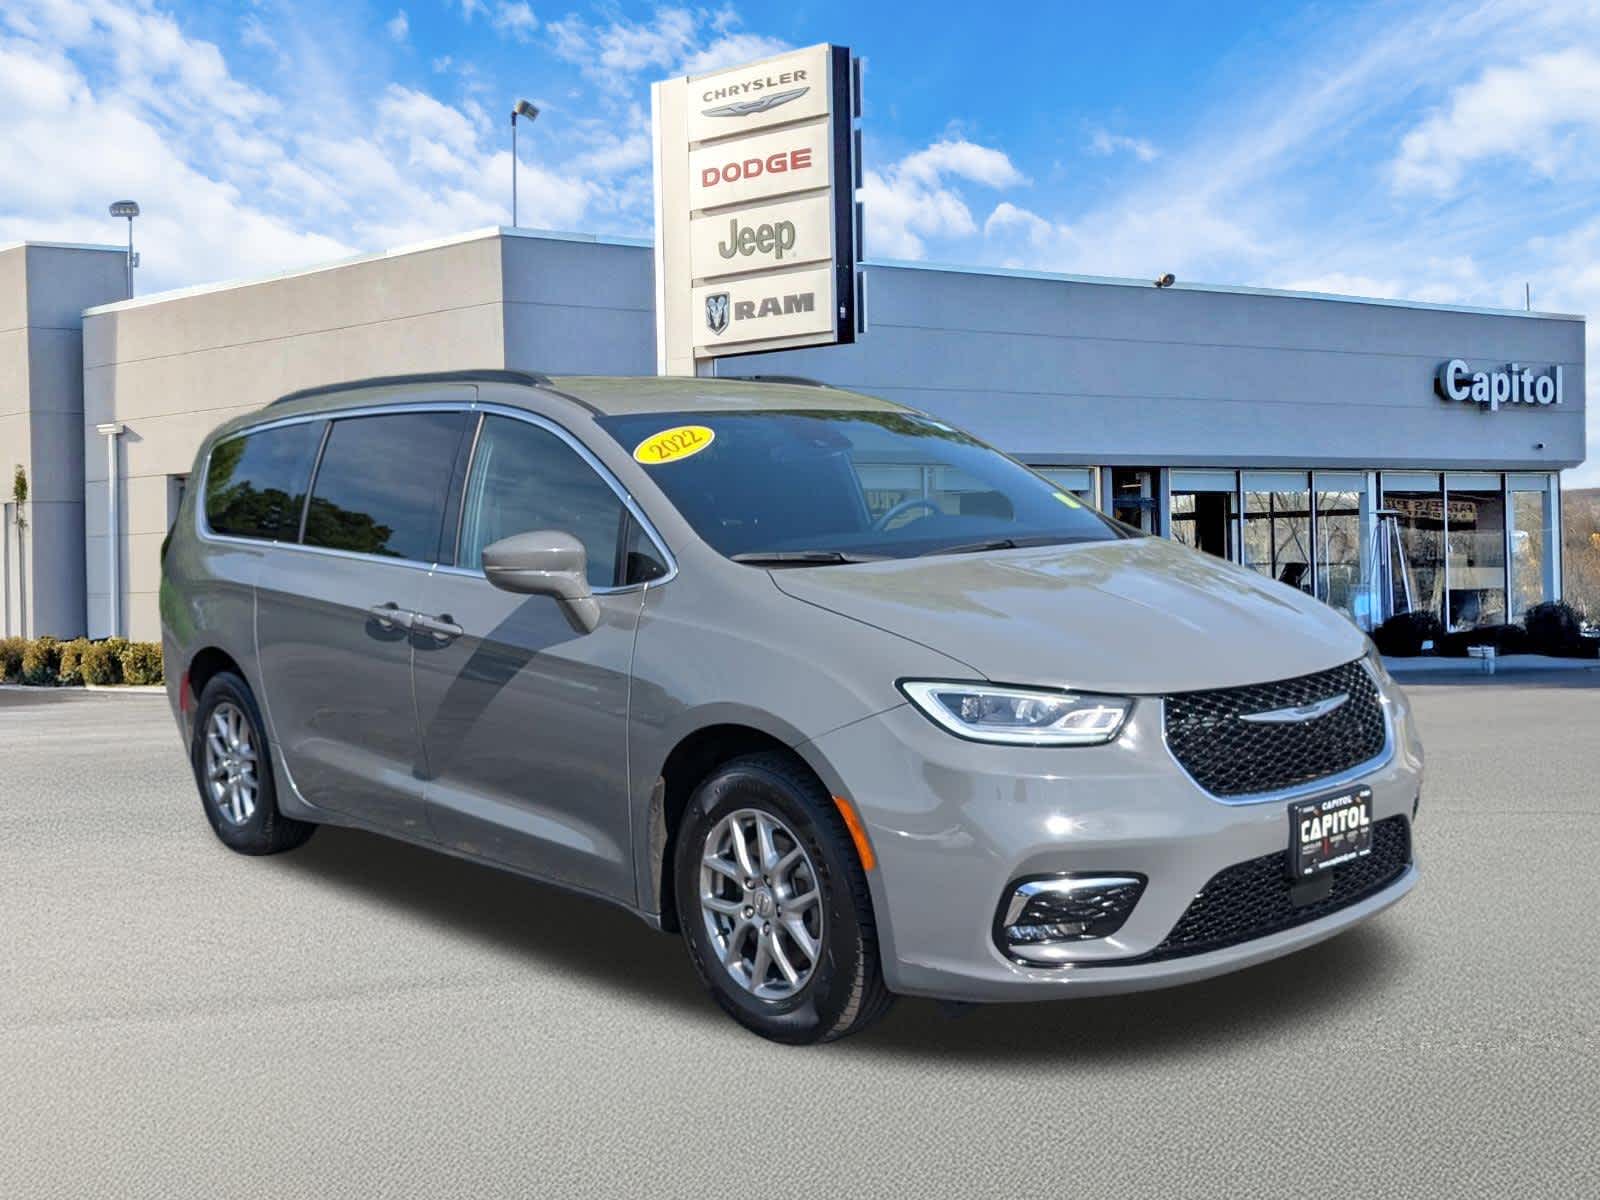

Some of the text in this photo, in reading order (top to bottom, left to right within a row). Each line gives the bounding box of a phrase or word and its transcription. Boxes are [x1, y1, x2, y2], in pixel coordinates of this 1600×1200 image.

[702, 70, 808, 103] CHRYSLER
[702, 148, 812, 187] DODGE
[718, 218, 796, 260] Jeep
[734, 292, 815, 321] RAM
[1446, 359, 1563, 411] Capitol
[649, 430, 703, 459] 2022
[1301, 804, 1369, 843] CAPITOL
